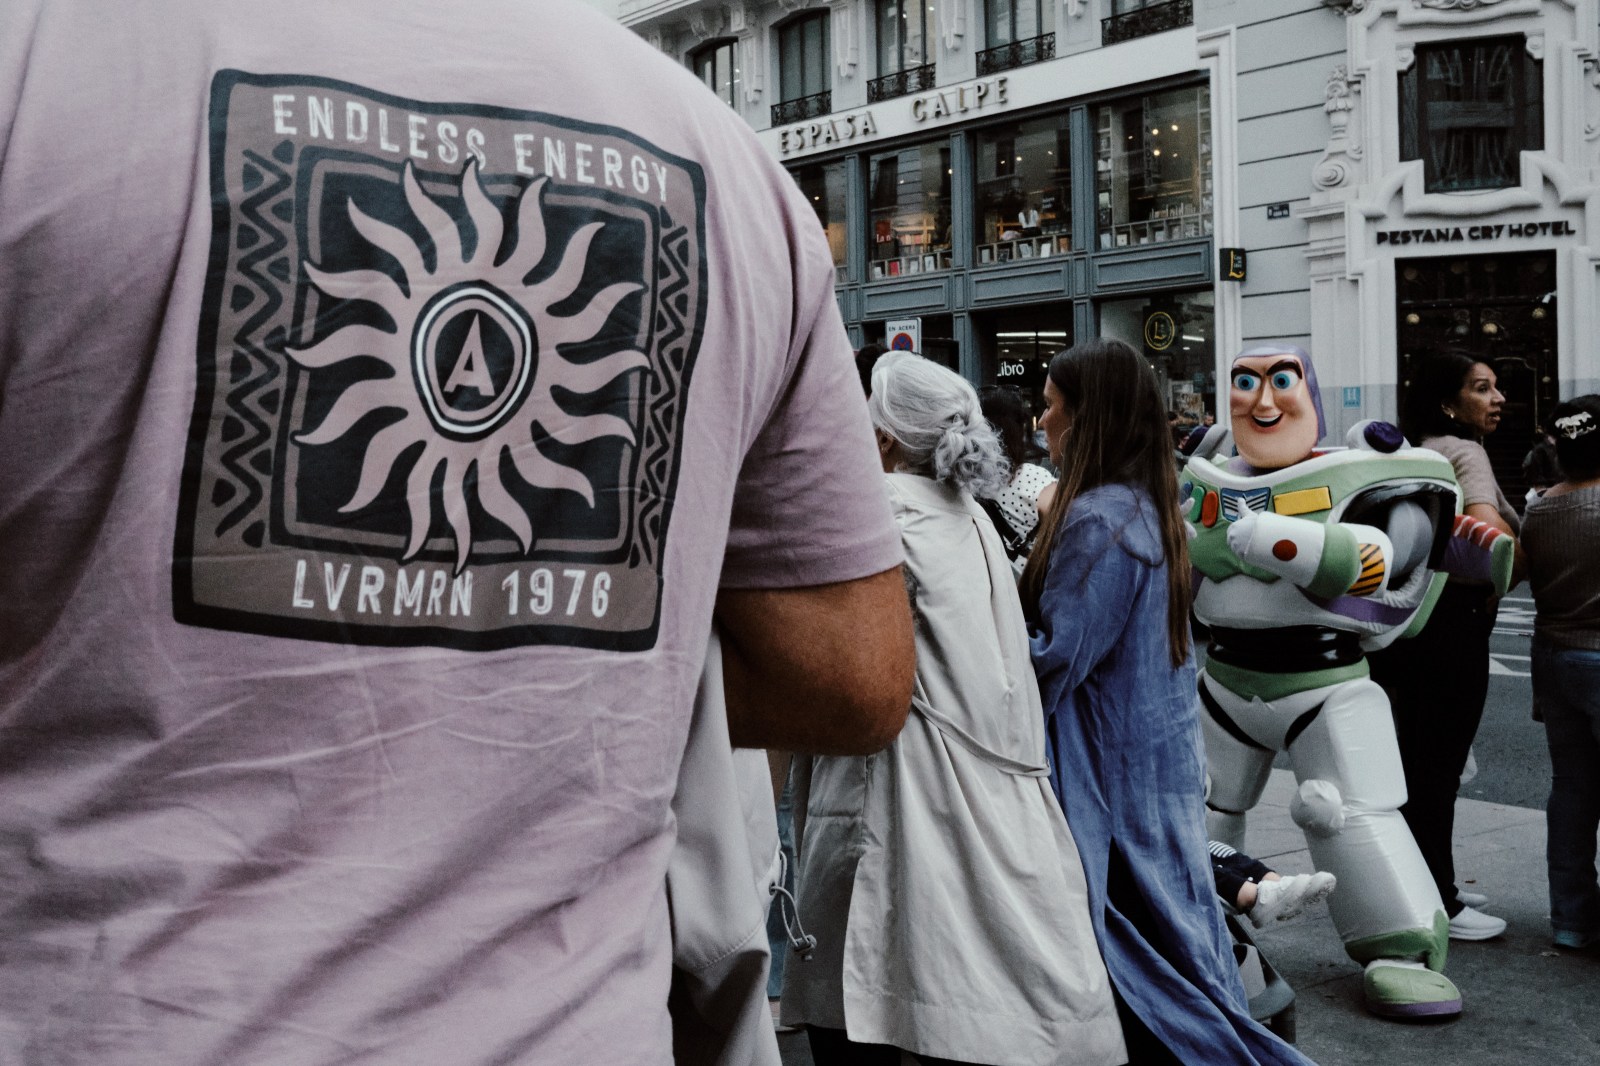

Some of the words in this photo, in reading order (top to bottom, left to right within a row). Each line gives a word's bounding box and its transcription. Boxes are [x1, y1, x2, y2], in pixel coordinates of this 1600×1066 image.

[272, 94, 487, 172] ENDLESS
[513, 132, 668, 202] ENERGY
[778, 111, 878, 154] ESPASA
[911, 76, 1009, 122] CALPE
[1376, 227, 1464, 246] PESTANA
[1467, 224, 1505, 241] CR7
[1508, 220, 1576, 238] HOTEL
[443, 312, 496, 397] A
[291, 559, 474, 617] LVRMRN
[501, 567, 612, 619] 1976
